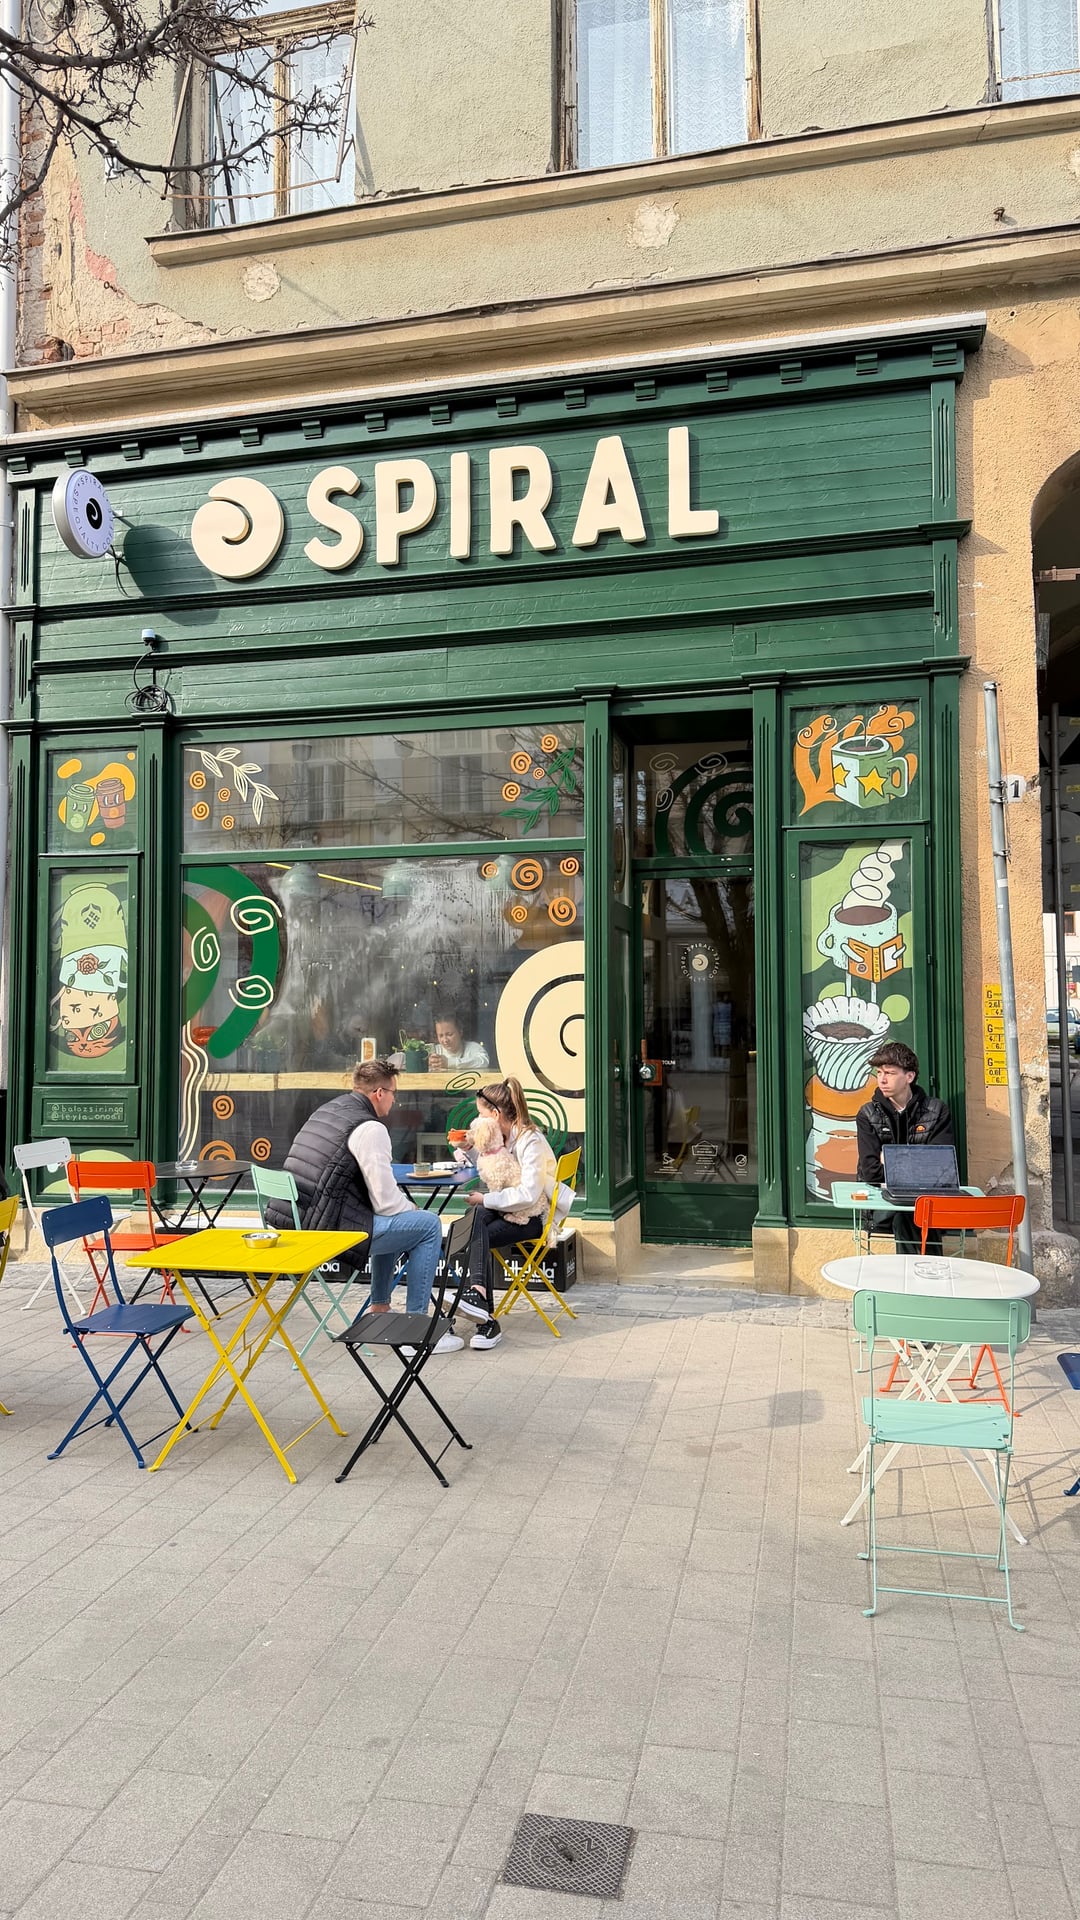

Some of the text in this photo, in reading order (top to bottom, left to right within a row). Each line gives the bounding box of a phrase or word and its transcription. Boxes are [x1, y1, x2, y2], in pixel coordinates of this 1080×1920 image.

[80, 475, 107, 498] SPIRAL
[304, 425, 721, 571] SPIRAL
[73, 488, 100, 552] SPECIALTY
[1009, 779, 1021, 798] 1
[686, 942, 711, 952] SPIRAL
[986, 990, 993, 999] G
[987, 1024, 993, 1033] G
[987, 1057, 993, 1066] G
